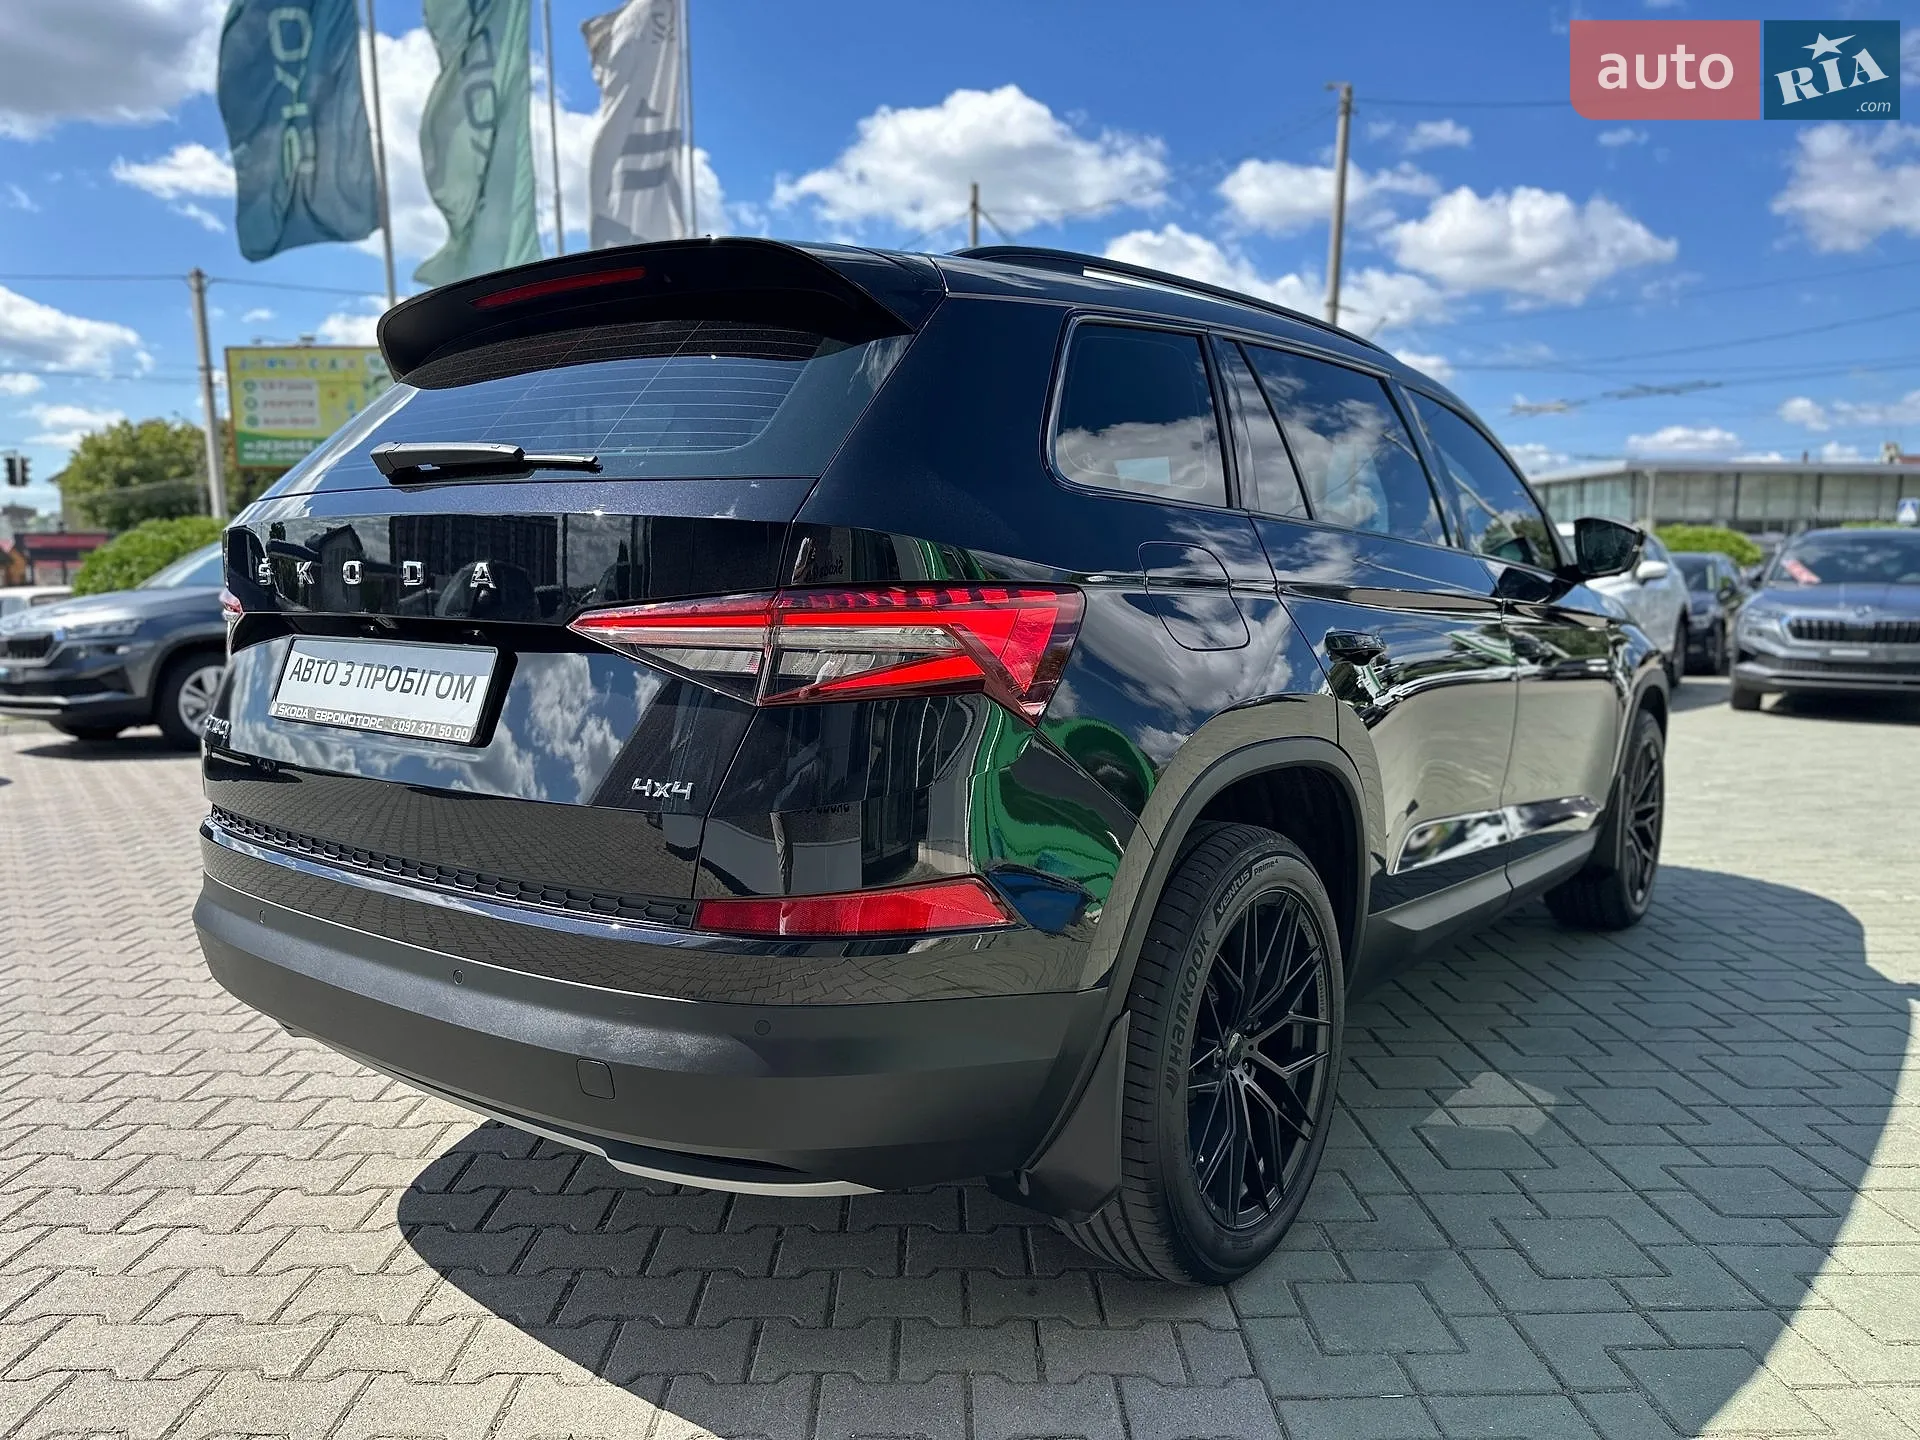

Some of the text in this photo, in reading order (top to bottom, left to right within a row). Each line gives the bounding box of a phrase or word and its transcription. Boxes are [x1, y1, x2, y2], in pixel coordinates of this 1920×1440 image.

[257, 557, 497, 589] ŠKODA
[288, 657, 339, 685] АВТО
[356, 663, 478, 703] ПРОБІГОМ
[277, 703, 309, 719] ŠKODA
[399, 721, 417, 732] 097
[418, 723, 437, 736] 371
[438, 725, 451, 737] 50
[454, 727, 469, 740] 00
[631, 777, 694, 800] 4x4
